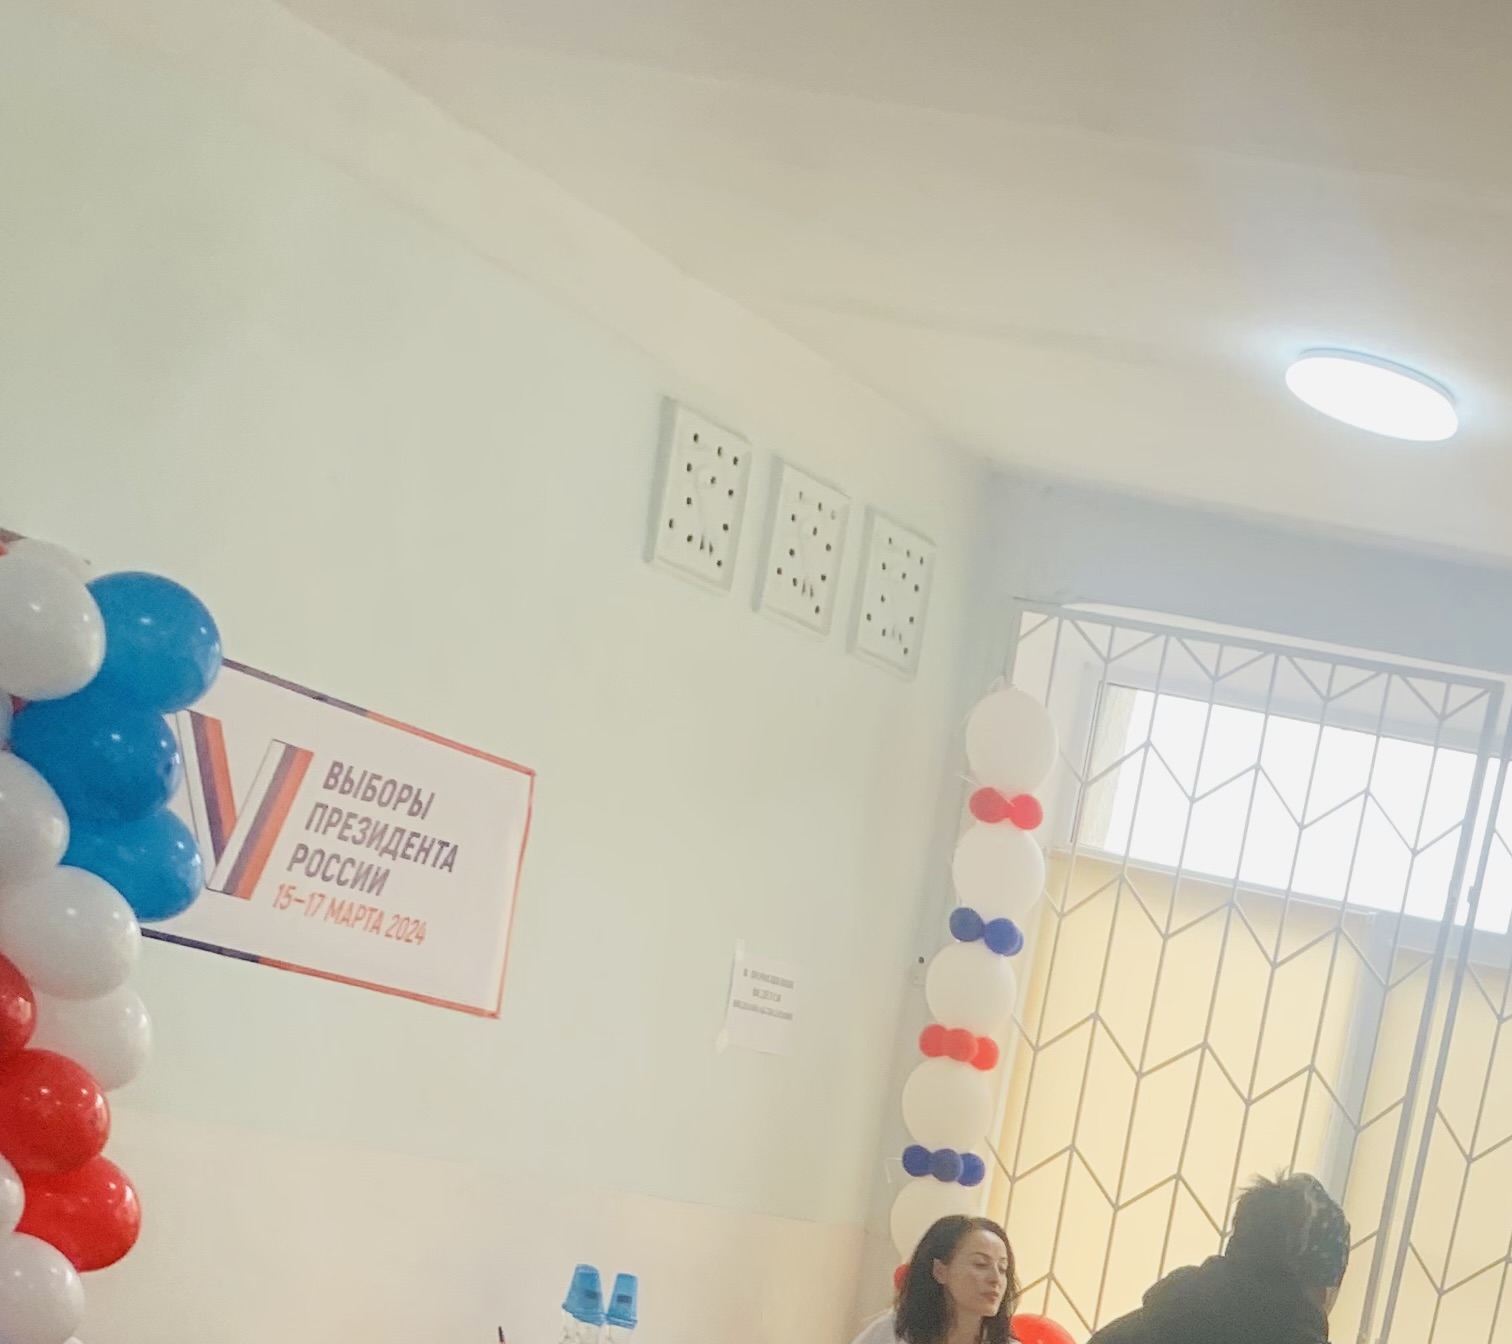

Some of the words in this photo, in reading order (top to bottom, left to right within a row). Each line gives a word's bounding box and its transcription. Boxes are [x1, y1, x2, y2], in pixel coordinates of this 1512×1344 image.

[322, 760, 435, 820] ВЫБОРЫ
[305, 801, 459, 873] ПРЕЗИДЕНТА
[286, 843, 391, 897] РОССИИ
[323, 897, 384, 935] МАРТА
[384, 914, 427, 946] 2024
